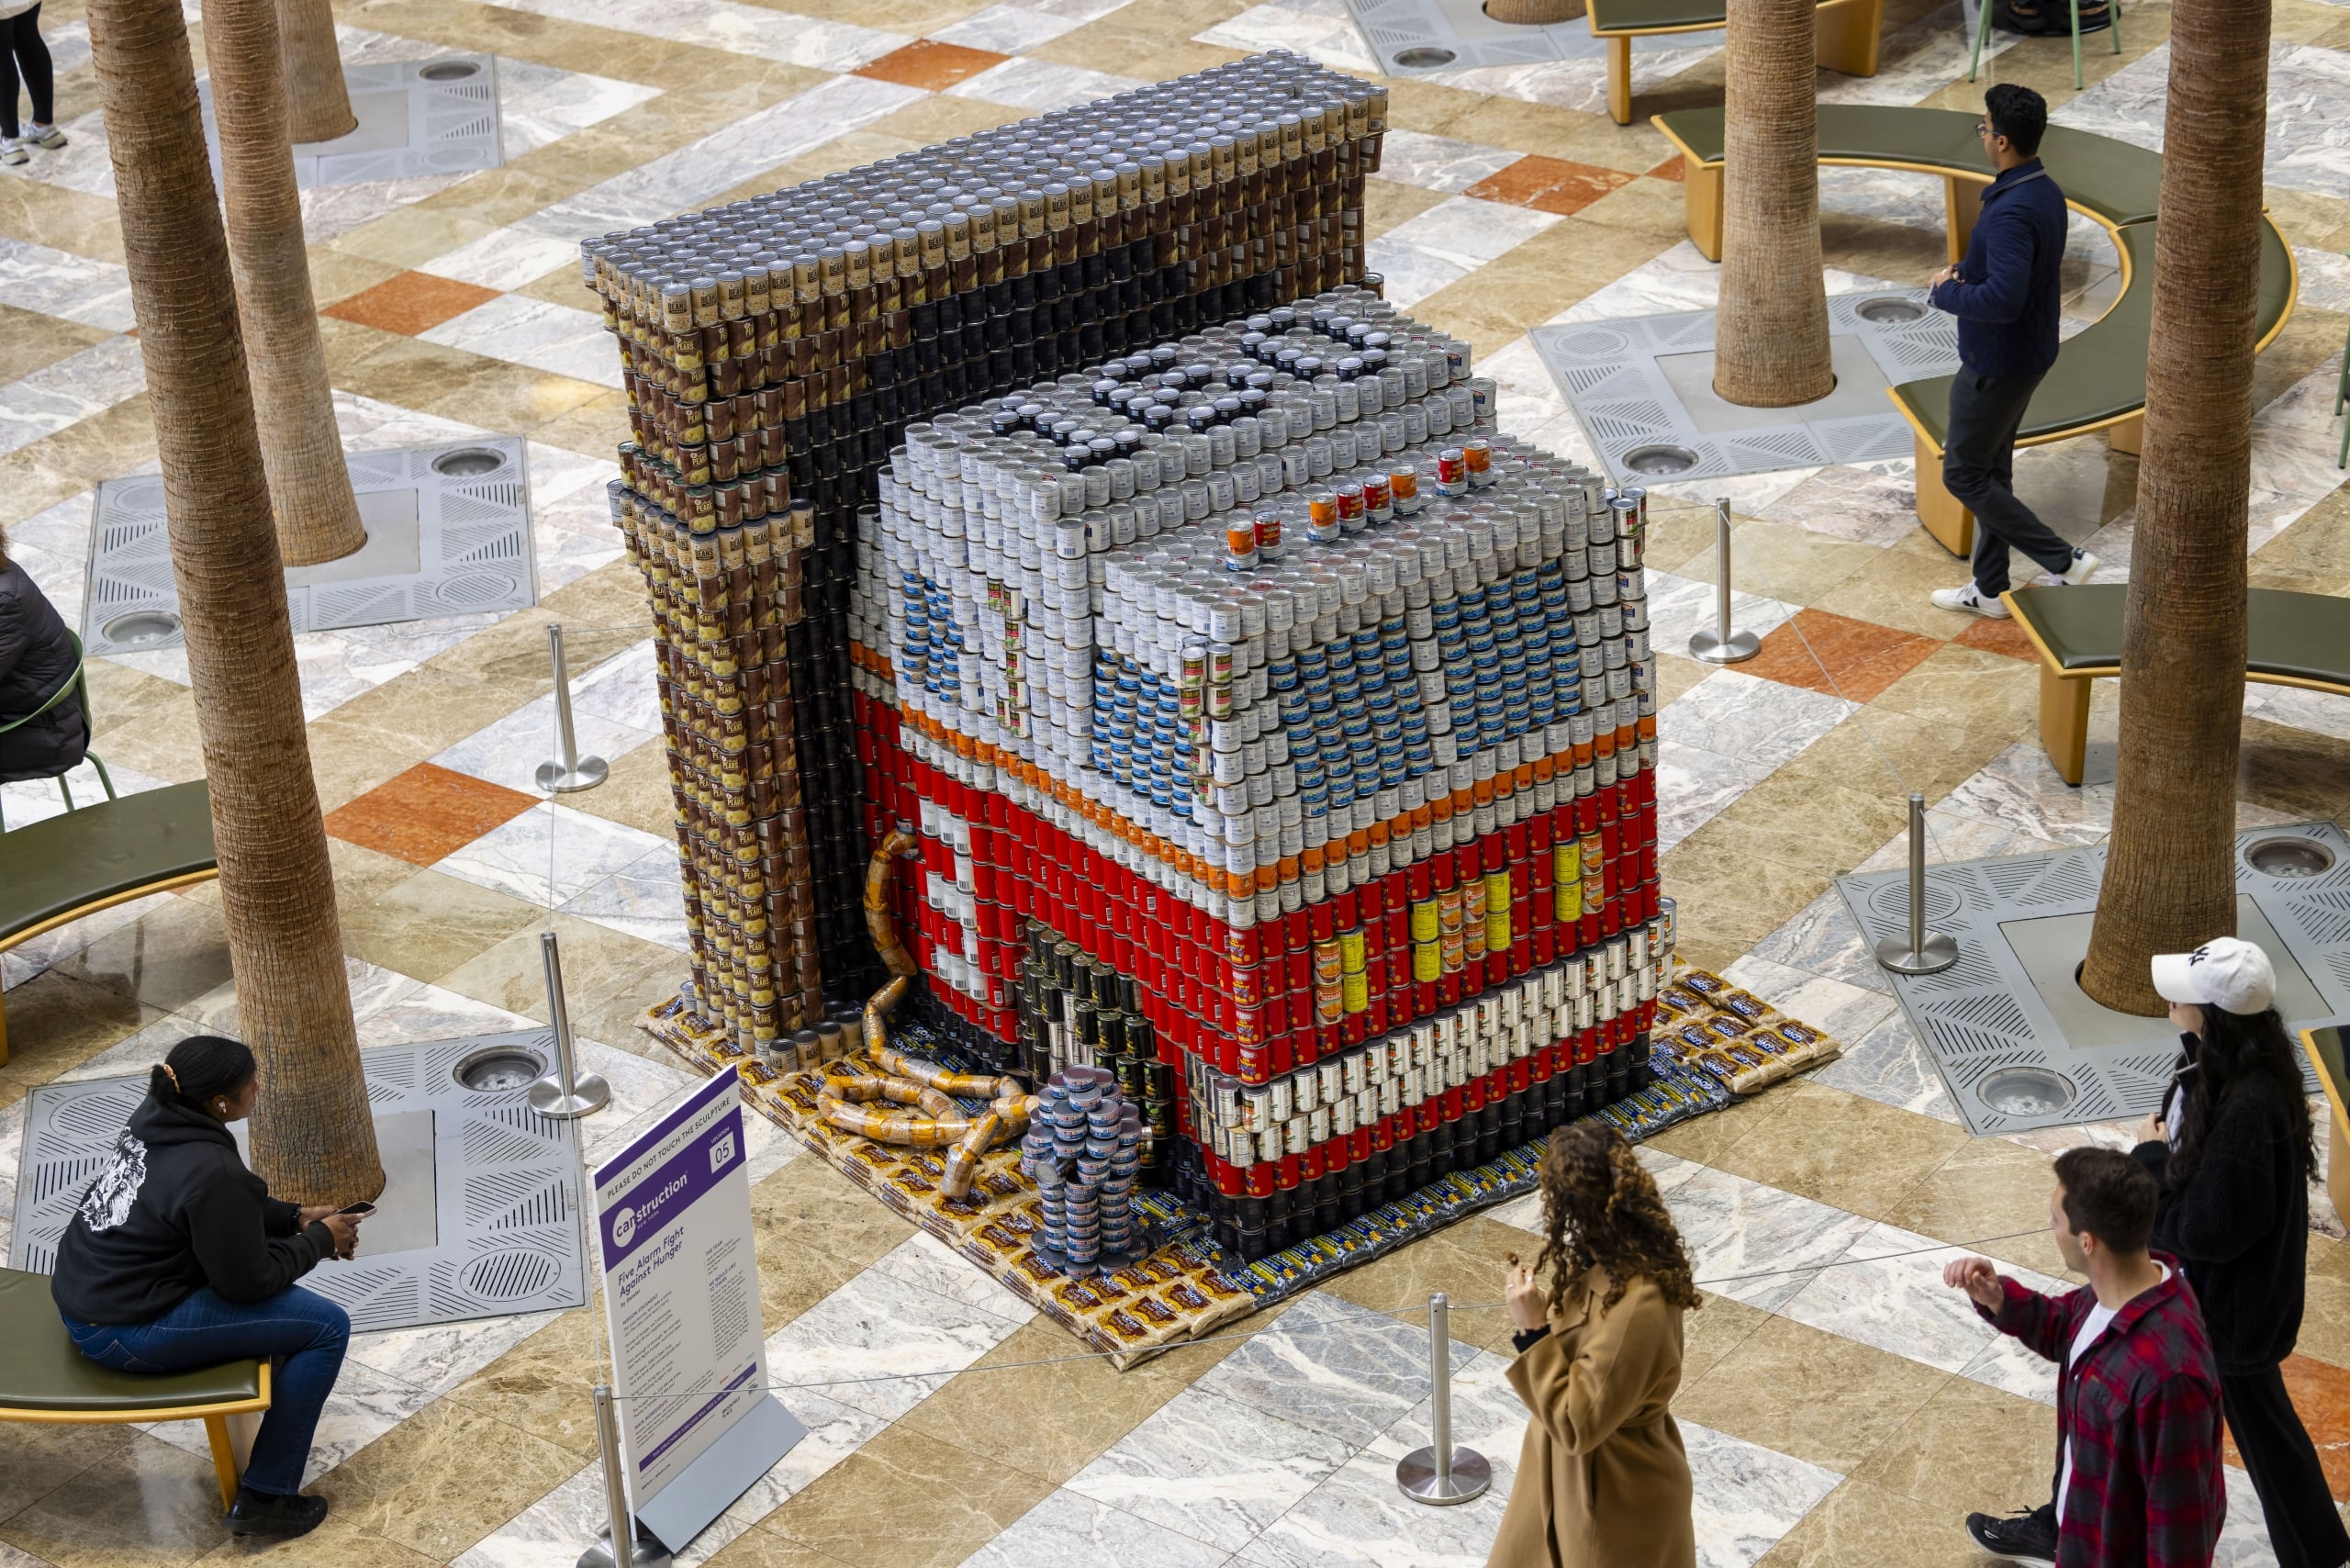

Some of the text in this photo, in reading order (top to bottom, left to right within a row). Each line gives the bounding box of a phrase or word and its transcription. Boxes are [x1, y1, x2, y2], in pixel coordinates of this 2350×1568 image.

[1732, 1001, 1751, 1015] GOYA
[1784, 1029, 1802, 1043] GOYA
[1756, 1038, 1775, 1053] GOYA
[1706, 1061, 1725, 1076] GOYA
[711, 1126, 730, 1144] LOCATION
[608, 1097, 730, 1199] PLEASE DO NOT TOUCH THE SCULPTURE
[715, 1143, 730, 1165] 05
[616, 1173, 688, 1238] canstruction
[618, 1226, 684, 1287] Five Alarm Fight
[1035, 1255, 1054, 1272] GOYA
[620, 1267, 651, 1297] Against
[653, 1240, 682, 1271] Hunger
[1243, 1269, 1266, 1284] GOYA
